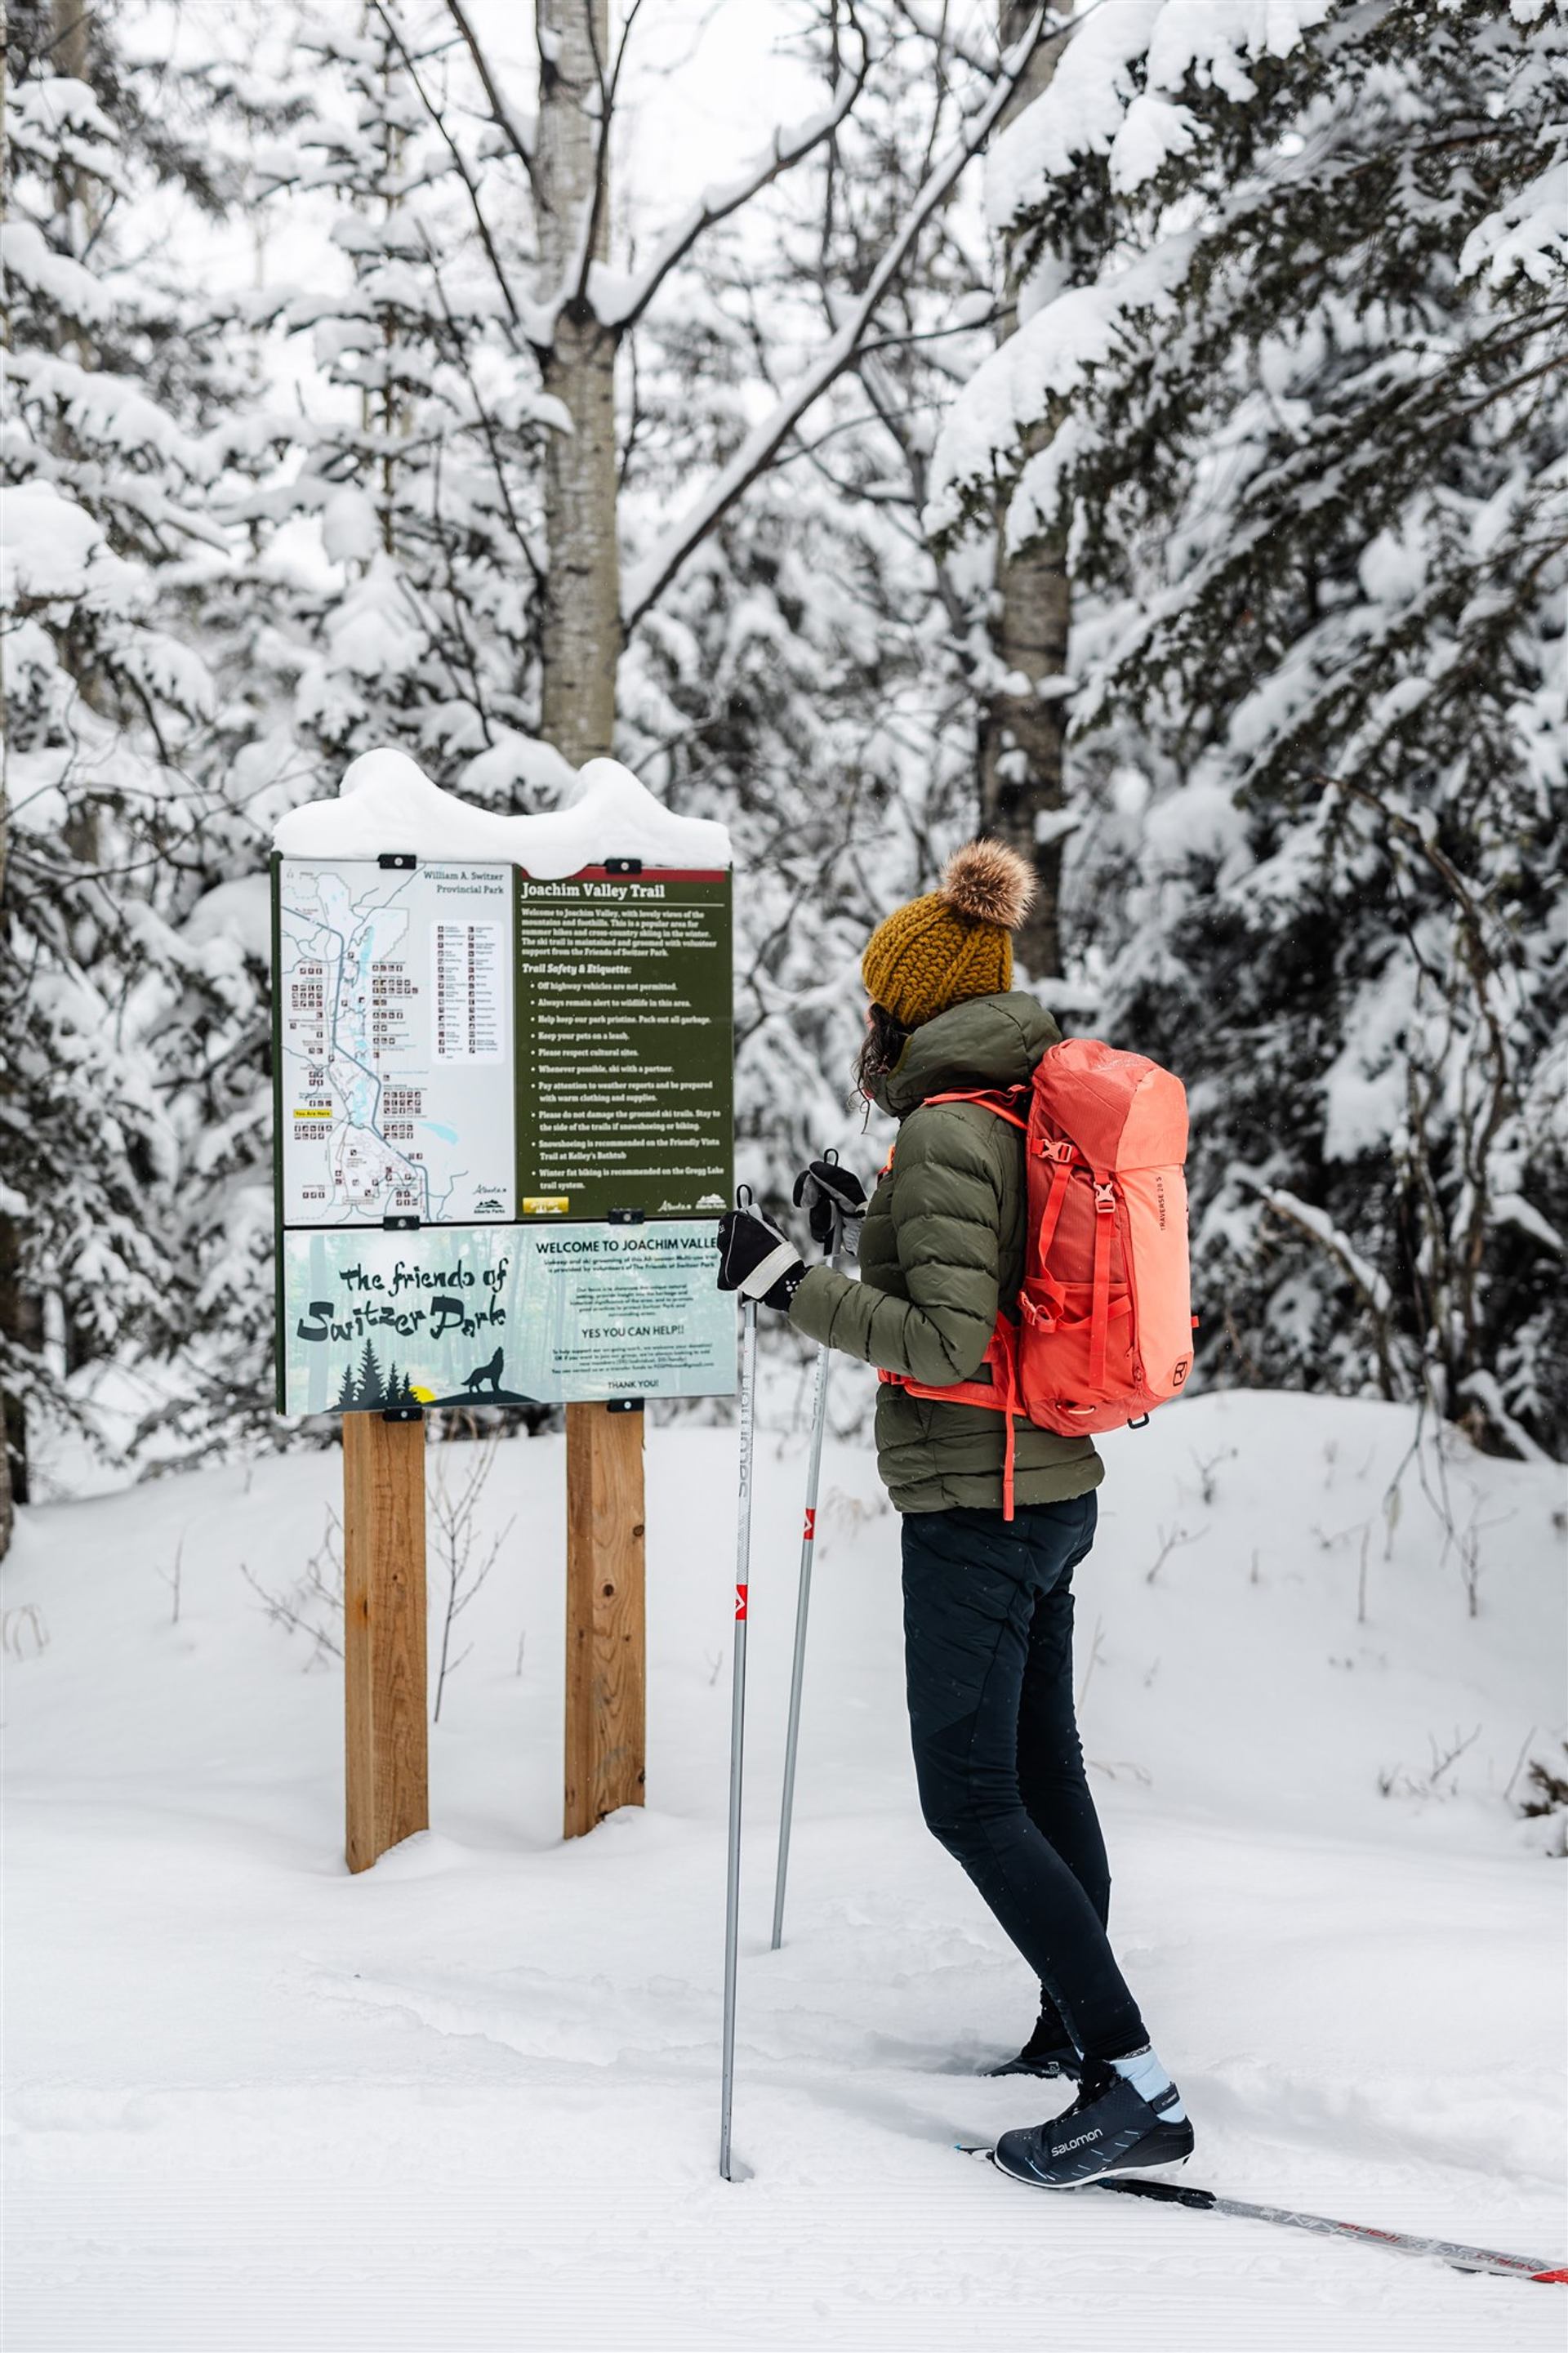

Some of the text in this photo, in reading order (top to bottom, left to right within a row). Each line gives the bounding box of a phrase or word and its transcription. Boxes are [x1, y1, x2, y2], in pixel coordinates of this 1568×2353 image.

[424, 871, 504, 880] William A. Switzer
[437, 885, 504, 894] Provincial Park
[521, 883, 666, 900] Joachim Valley Trail
[639, 911, 660, 920] lovely
[631, 939, 663, 948] groomed
[522, 948, 550, 957] support
[522, 964, 631, 976] Trail Safety & Etiquette:
[550, 983, 581, 992] highway
[538, 1000, 564, 1008] Always
[538, 1032, 556, 1041] Keep
[576, 1032, 590, 1041] pets
[562, 1049, 588, 1058] respect
[539, 1082, 551, 1091] Pay
[628, 1082, 654, 1090] reports
[679, 1081, 712, 1090] prepared
[580, 1094, 609, 1103] clothing
[586, 1111, 614, 1120] damage
[629, 1111, 660, 1119] groomed
[696, 1110, 710, 1119] Stay
[619, 1123, 665, 1132] snowshoeing
[539, 1140, 586, 1149] Snowshoeing
[670, 1139, 699, 1148] Friendly
[685, 1167, 706, 1176] Gregg
[536, 1238, 717, 1254] WELCOME TO JOACHIM VALLE
[339, 1258, 509, 1297] The friends of
[296, 1294, 506, 1341] Switzer Park
[581, 1325, 684, 1338] YES YOU CAN HELP!!
[608, 1379, 659, 1388] THANK YOU!
[1051, 2128, 1102, 2158] salomon
